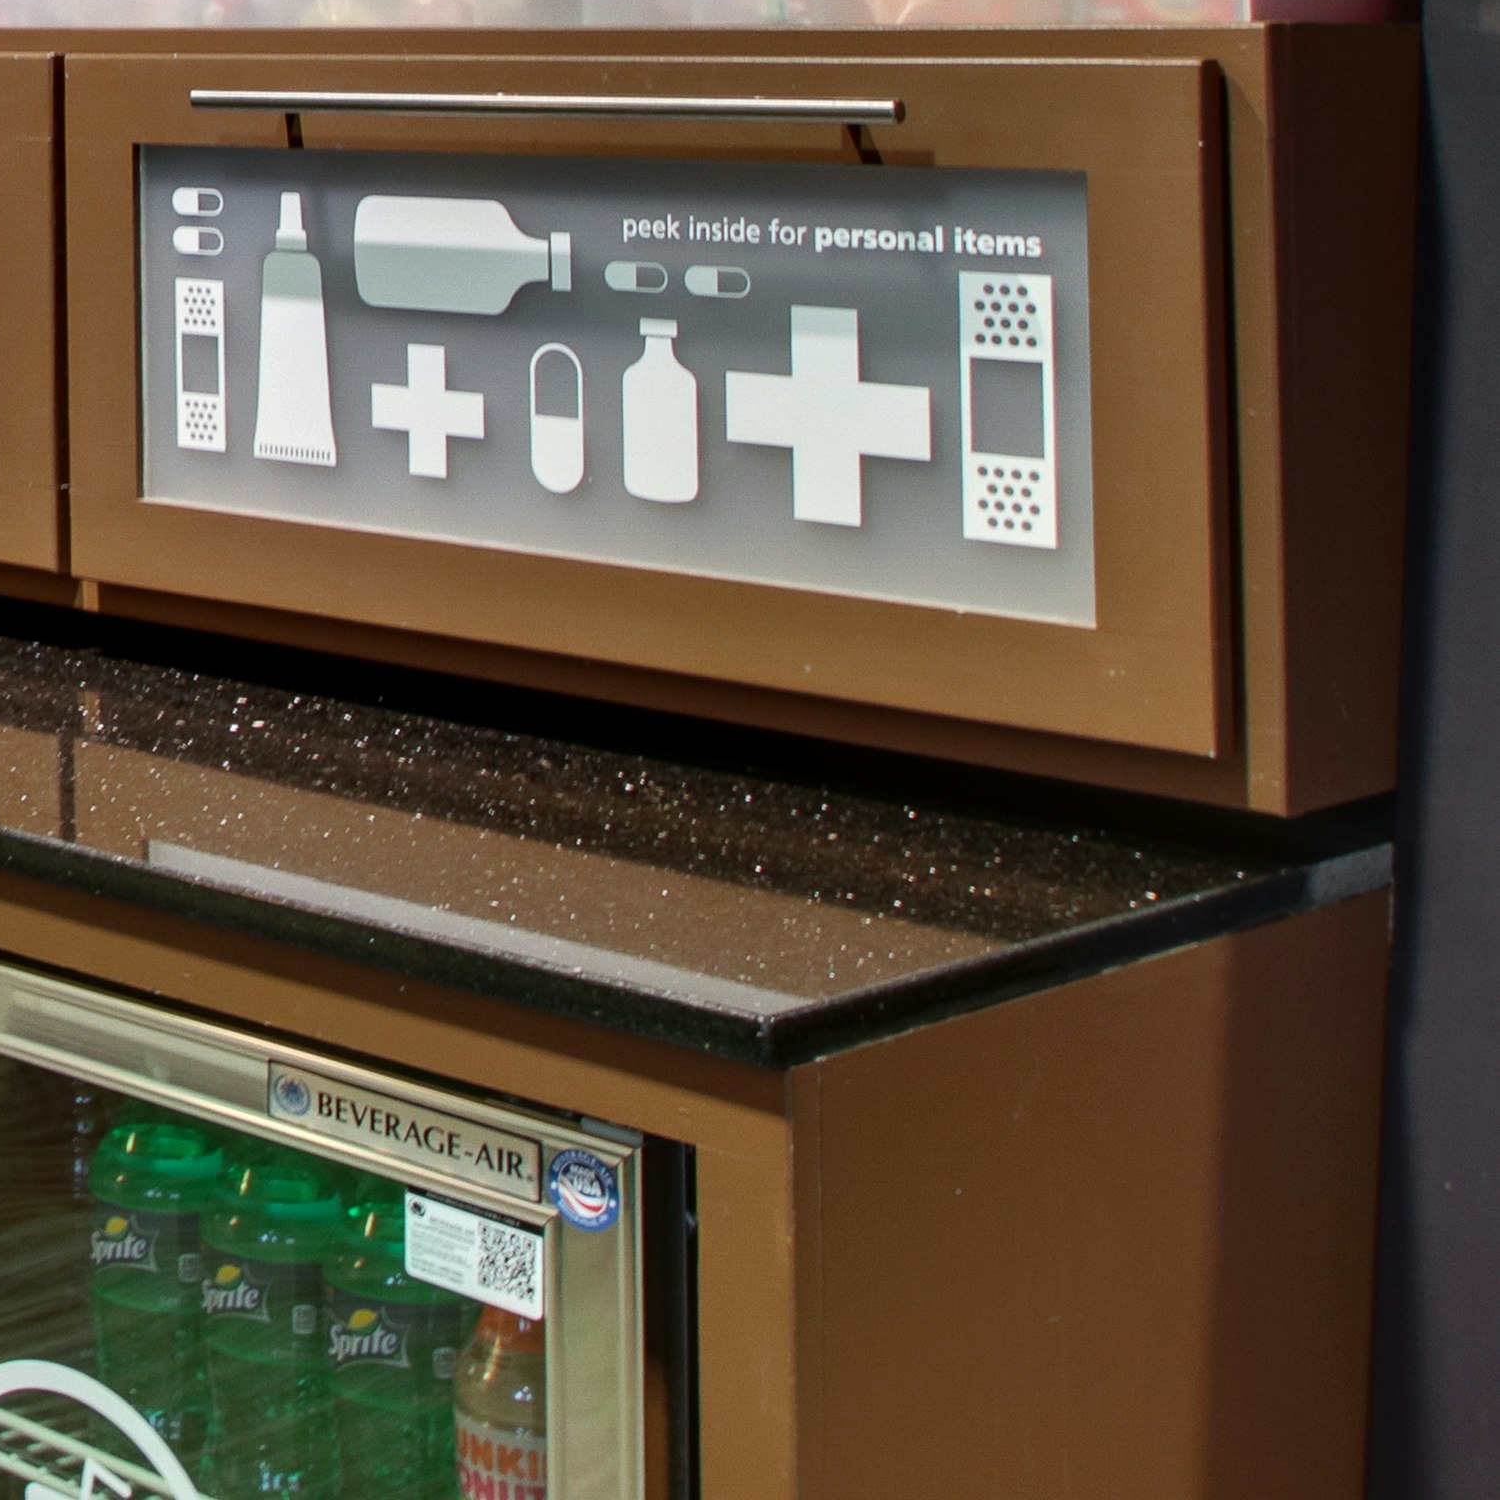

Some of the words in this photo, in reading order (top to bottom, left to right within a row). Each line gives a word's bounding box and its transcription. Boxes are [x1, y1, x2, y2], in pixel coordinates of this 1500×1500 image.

[622, 214, 680, 243] peek
[688, 214, 760, 244] inside
[768, 218, 807, 246] for
[814, 225, 944, 254] personal
[953, 226, 1043, 258] items
[317, 1090, 525, 1179] BEVERAGE-AIR
[573, 1176, 603, 1197] USA
[90, 1229, 146, 1265] Sprite
[202, 1278, 260, 1314] Sprite
[327, 1323, 398, 1362] Sprite
